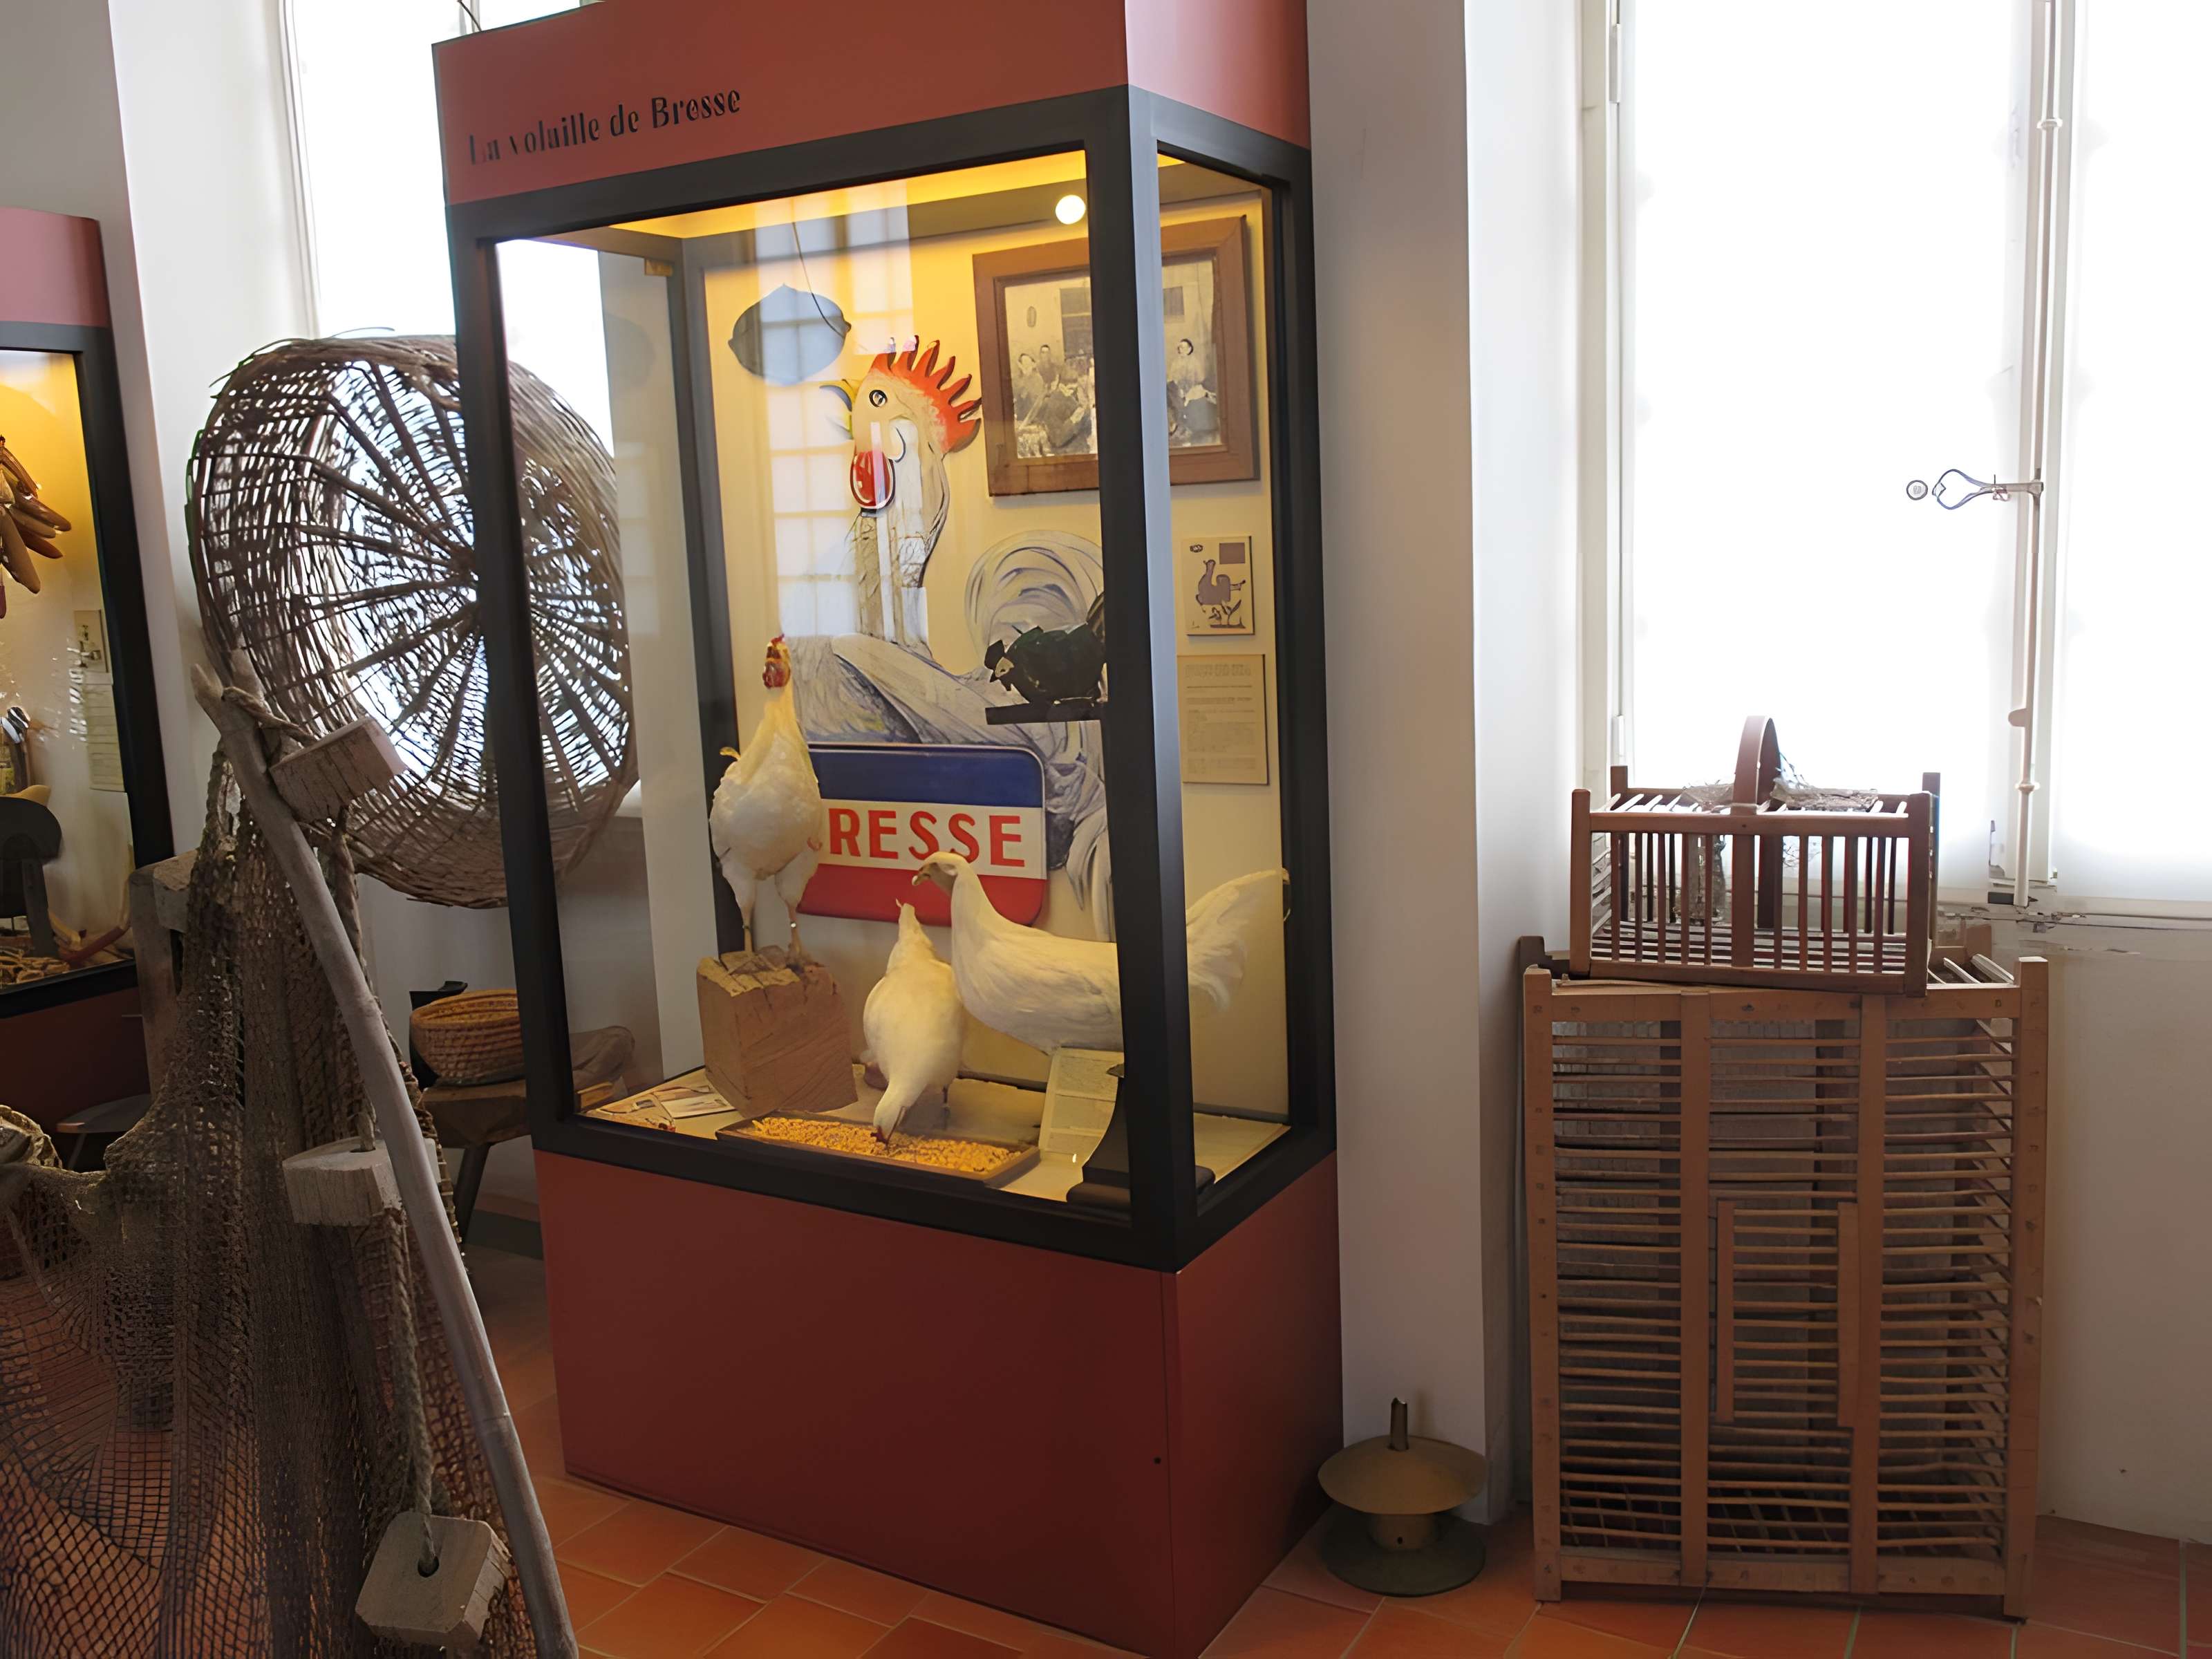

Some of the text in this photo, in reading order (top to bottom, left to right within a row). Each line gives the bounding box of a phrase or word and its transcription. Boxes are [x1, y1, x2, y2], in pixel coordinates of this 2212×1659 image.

[610, 104, 639, 137] de
[651, 89, 741, 129] Bresse
[827, 807, 1025, 868] RESSE
